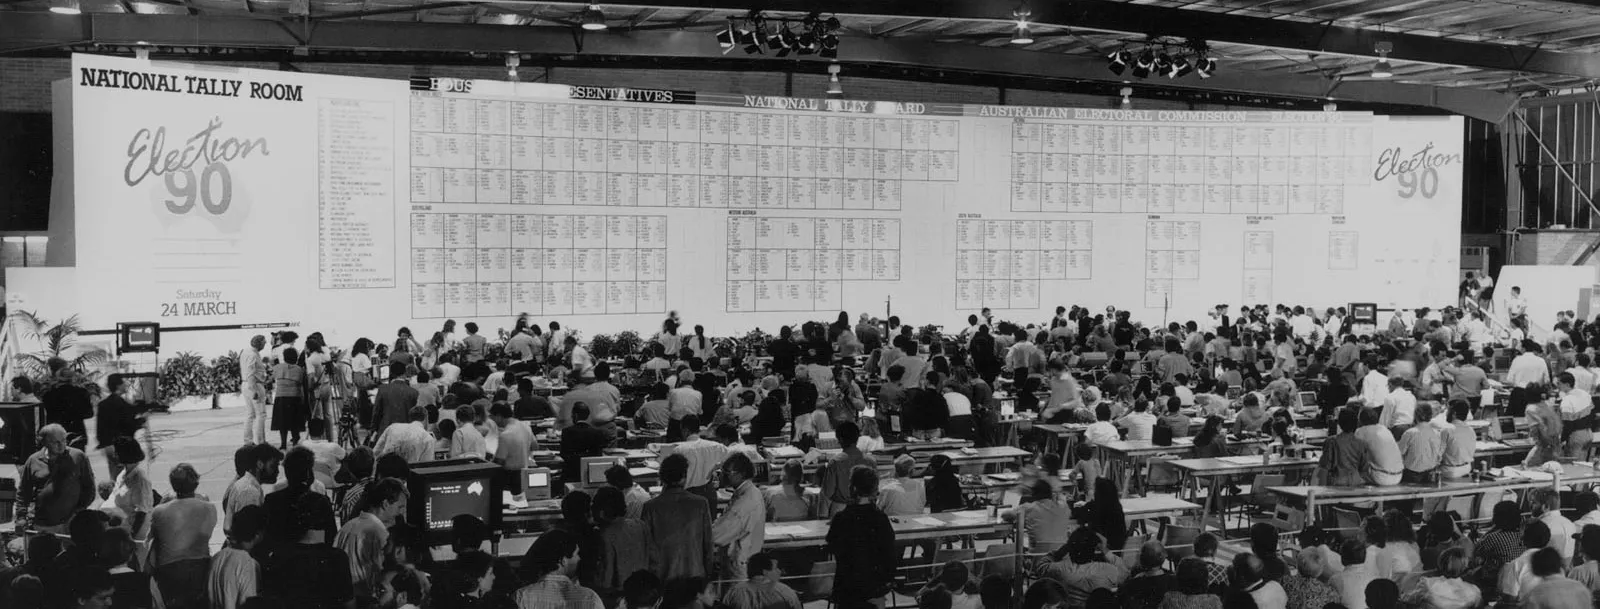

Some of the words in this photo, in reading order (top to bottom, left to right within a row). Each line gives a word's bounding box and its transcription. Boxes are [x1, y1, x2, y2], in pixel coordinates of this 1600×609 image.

[80, 68, 181, 93] NATIONAL
[185, 76, 243, 97] TALLY
[250, 82, 303, 101] ROOM
[429, 77, 474, 92] HOUS
[568, 86, 674, 103] ESENTATIVES
[744, 95, 818, 110] NATIONAL
[979, 105, 1068, 119] AUSTRALIAN
[1074, 107, 1153, 121] ELECTORAL
[1157, 109, 1247, 122] COMMISSION
[124, 115, 270, 187] Election
[1374, 141, 1462, 181] Election
[164, 162, 232, 215] 90
[1397, 168, 1439, 199] 90
[161, 303, 179, 317] 24
[184, 301, 237, 316] MARCH
[176, 289, 222, 301] Saturday
